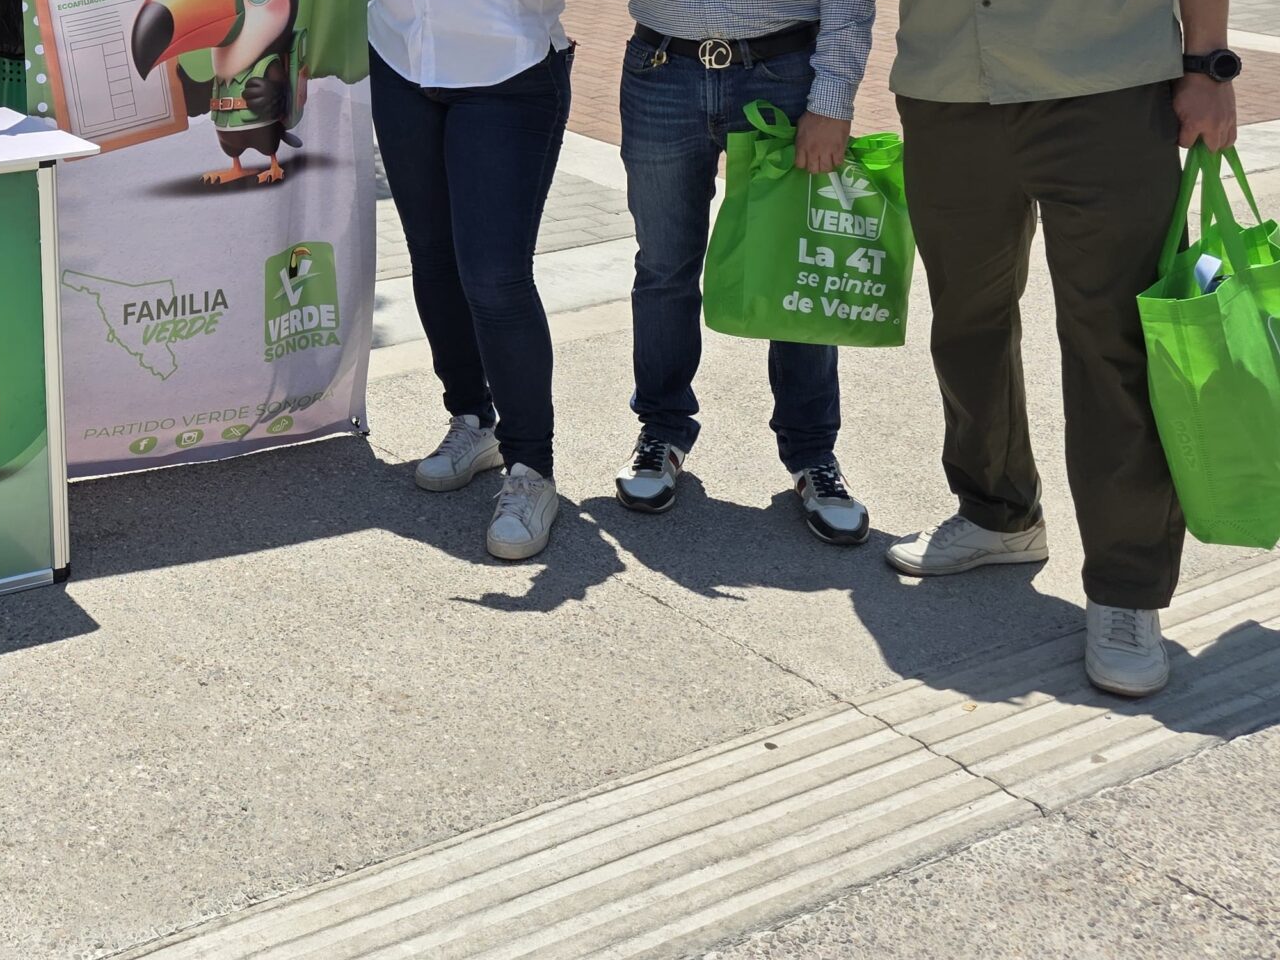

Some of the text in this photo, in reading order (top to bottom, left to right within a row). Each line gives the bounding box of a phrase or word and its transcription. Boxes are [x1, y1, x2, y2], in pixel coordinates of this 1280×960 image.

[811, 208, 879, 238] VERDE
[798, 238, 886, 275] La 4T
[797, 271, 886, 297] se pinta
[123, 289, 229, 325] FAMILIA
[782, 291, 890, 322] de Verde
[143, 312, 223, 345] VERDE
[268, 304, 337, 343] VERDE
[264, 332, 342, 363] SONORA
[83, 417, 176, 440] PARTIDO
[182, 406, 250, 426] VERDE
